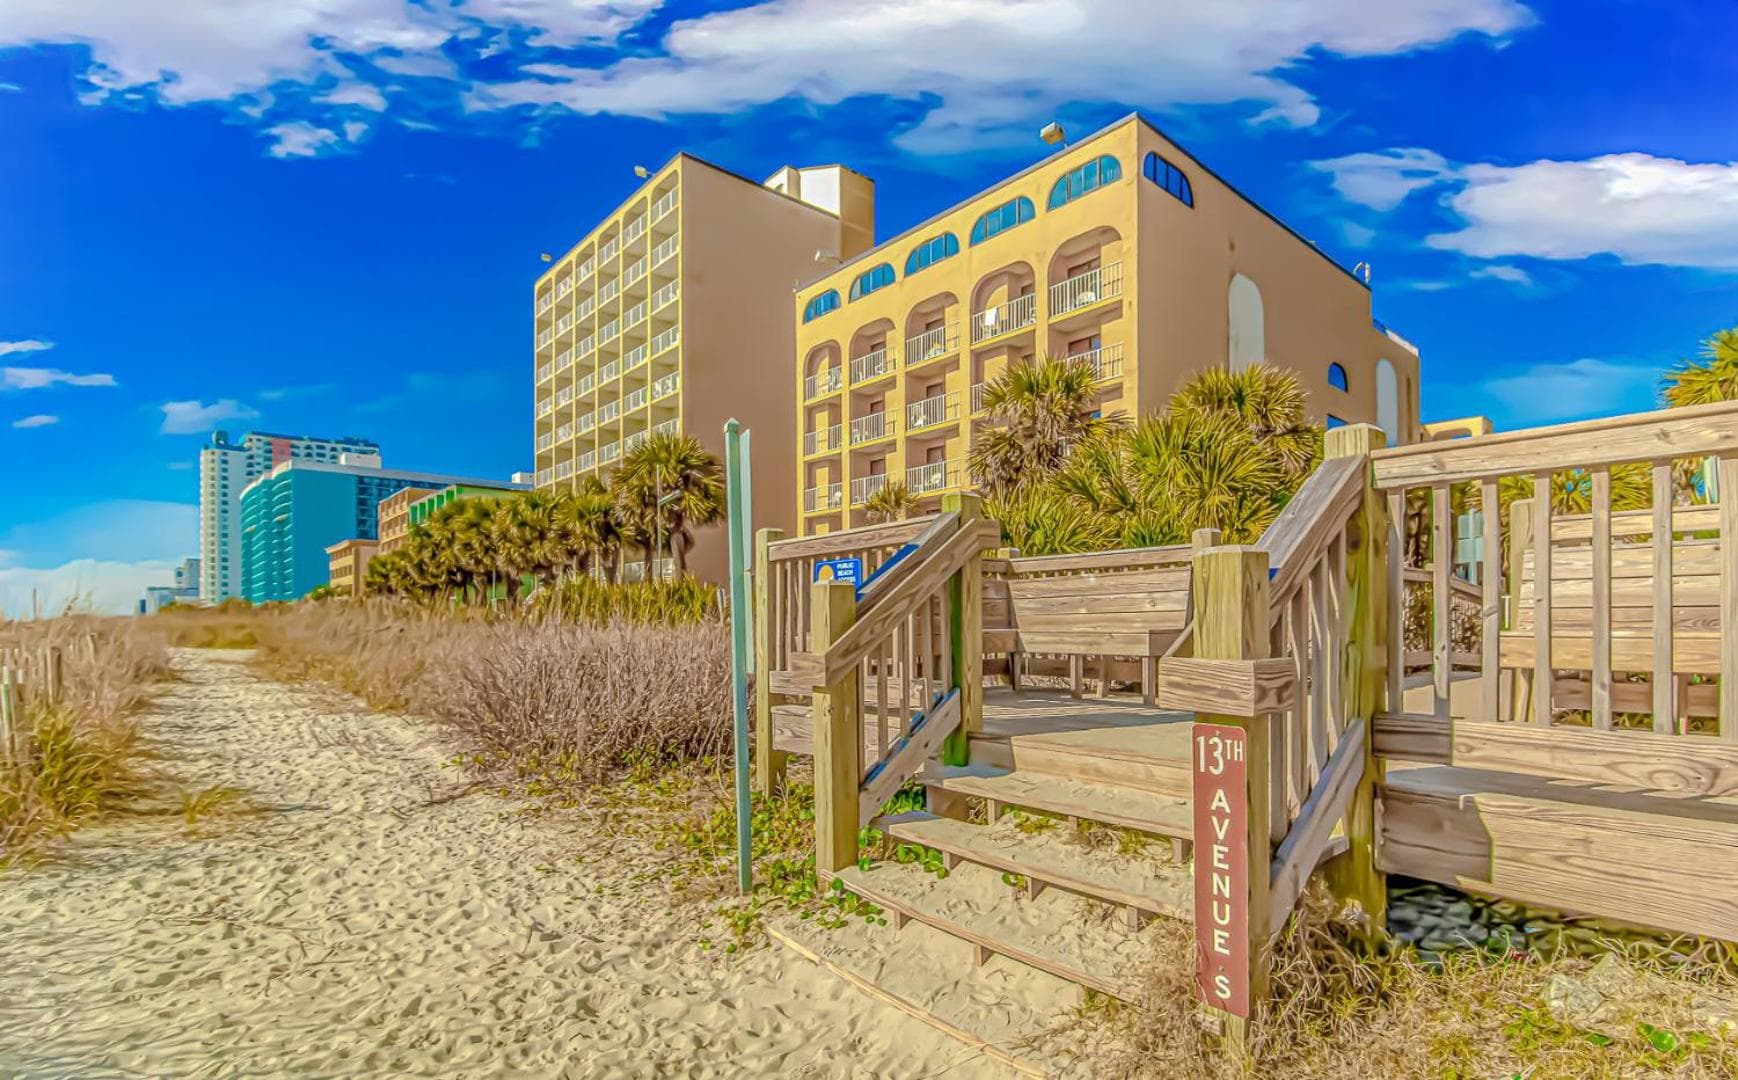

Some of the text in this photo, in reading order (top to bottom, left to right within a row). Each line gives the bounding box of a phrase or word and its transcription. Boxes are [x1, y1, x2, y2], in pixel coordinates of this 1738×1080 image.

[836, 561, 855, 570] PUBLIC
[837, 569, 854, 577] BEACH
[1196, 736, 1244, 776] 13TH
[1210, 788, 1232, 1000] AVENUE S
